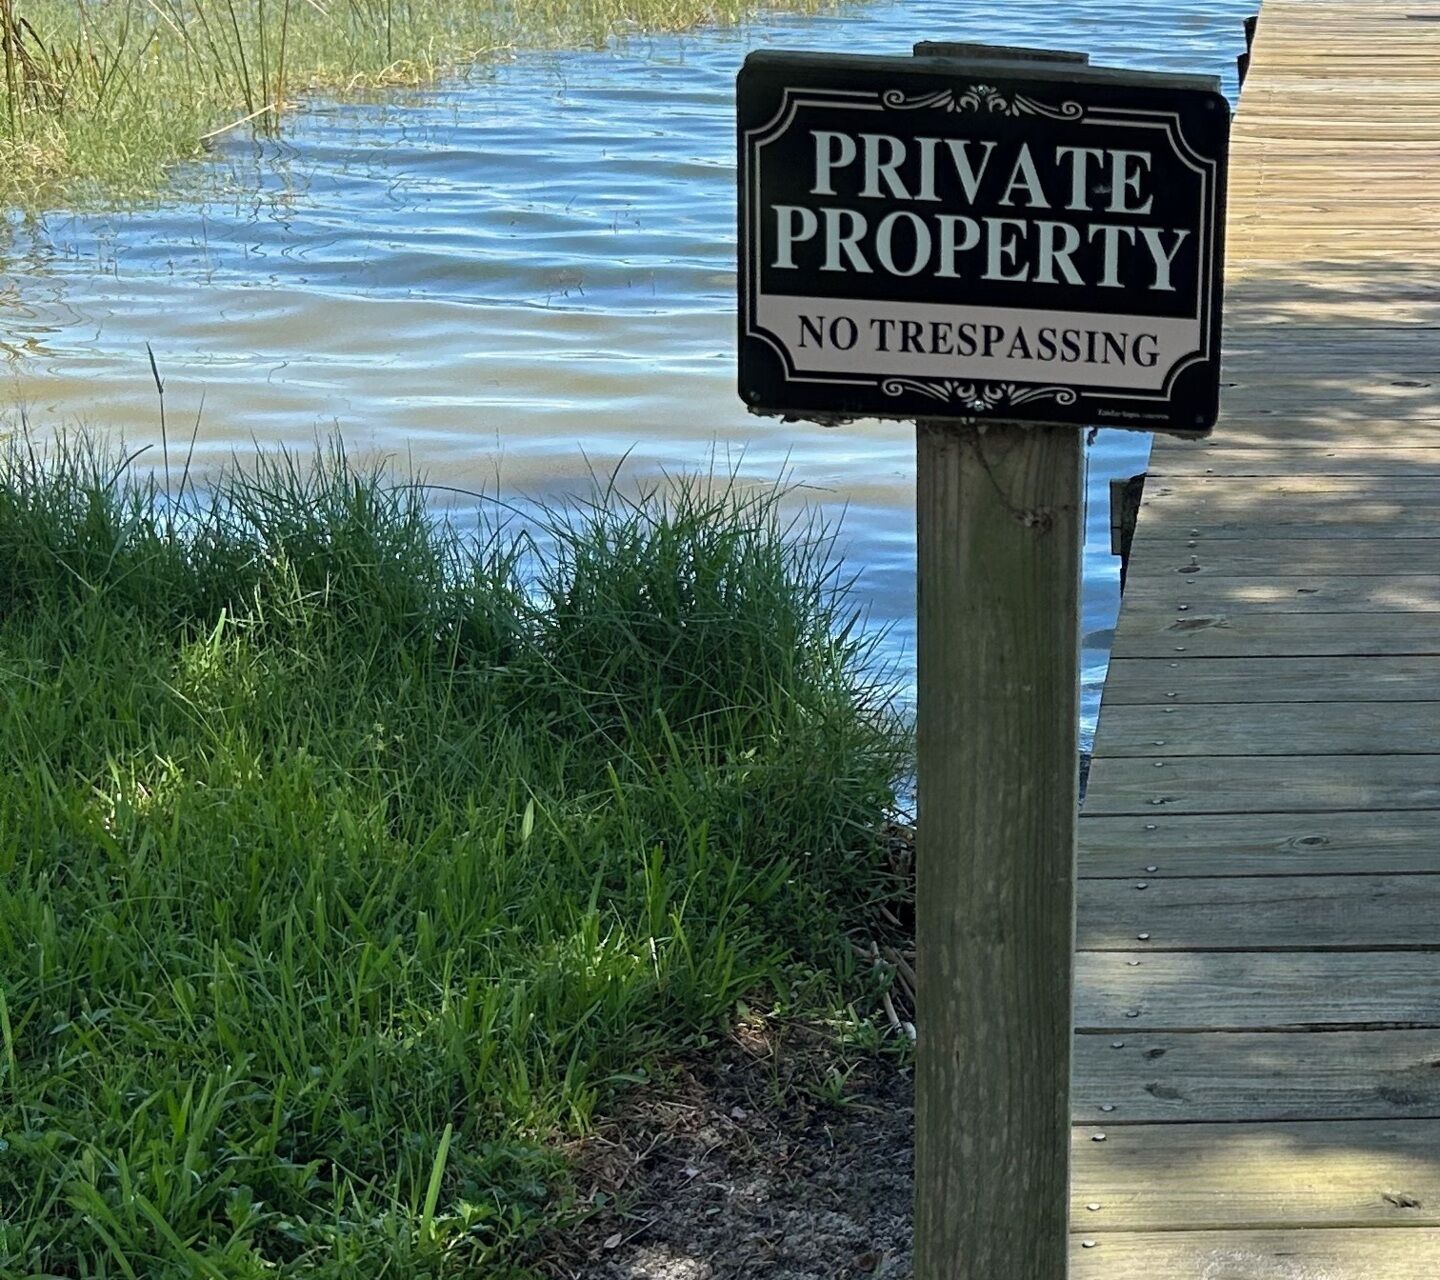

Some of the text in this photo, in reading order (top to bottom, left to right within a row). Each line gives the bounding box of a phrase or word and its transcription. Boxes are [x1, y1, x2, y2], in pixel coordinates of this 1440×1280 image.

[808, 129, 1154, 216] PRIVATE
[770, 204, 1191, 292] PROPERTY
[797, 315, 1161, 368] NO TRESPASSING
